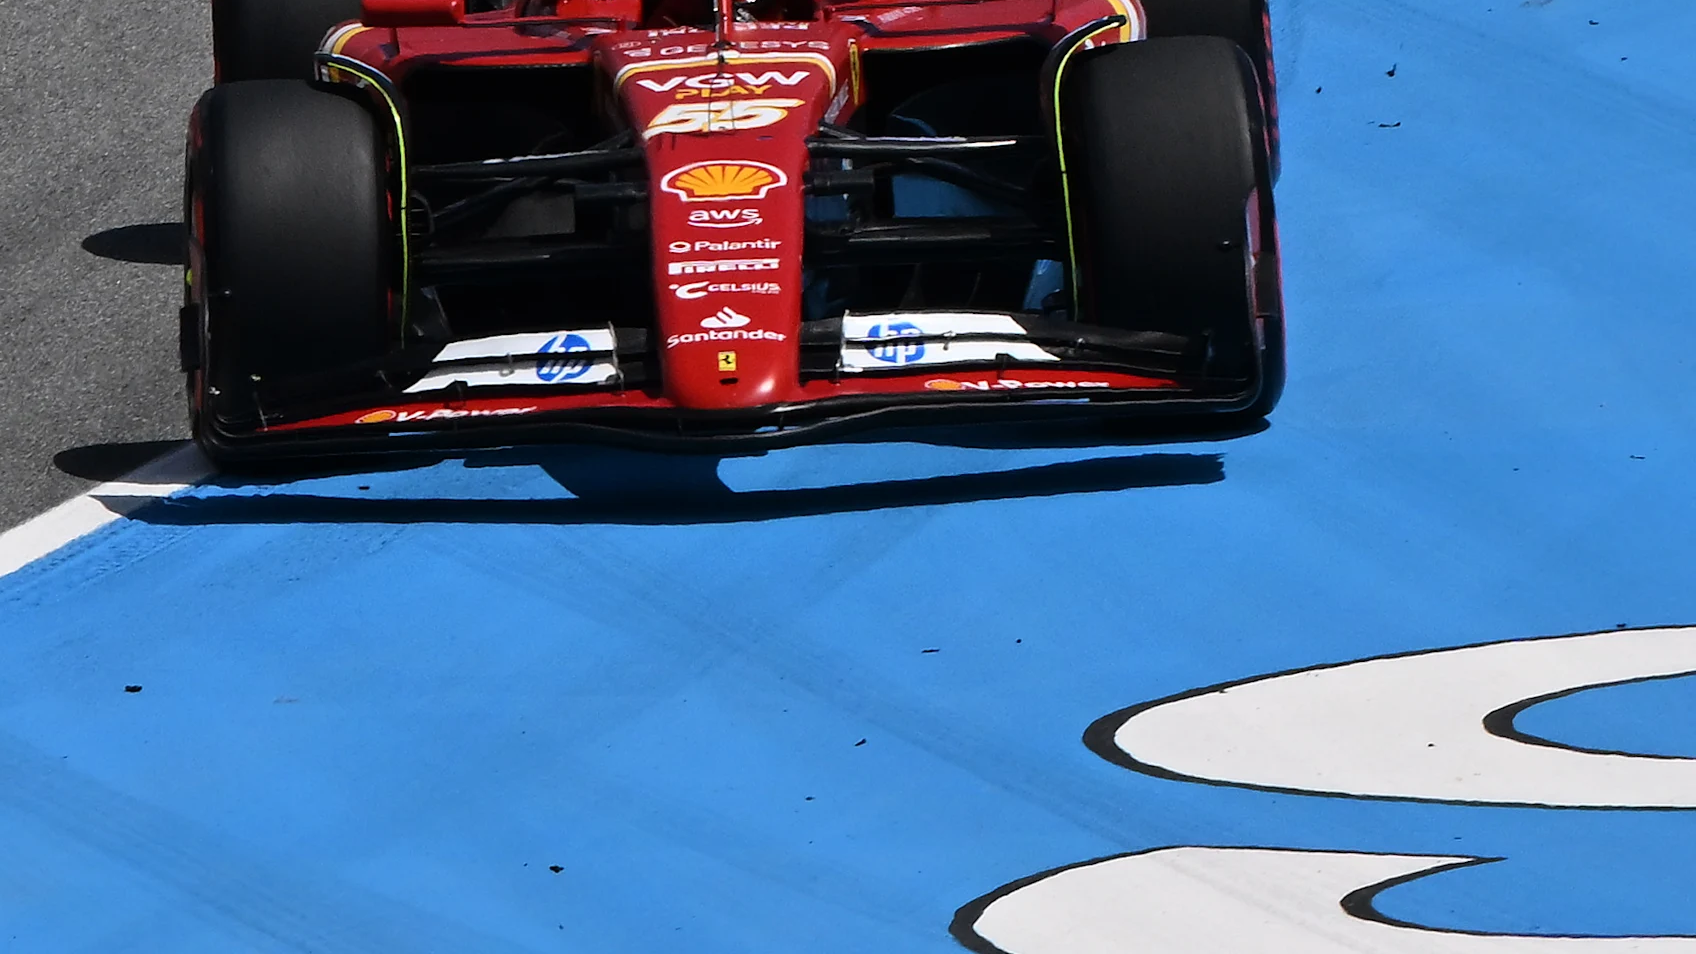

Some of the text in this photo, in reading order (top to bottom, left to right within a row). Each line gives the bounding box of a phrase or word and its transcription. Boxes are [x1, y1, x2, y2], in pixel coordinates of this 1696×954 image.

[636, 71, 810, 93] VGW
[675, 84, 773, 100] PLAY
[641, 98, 806, 142] 55
[688, 208, 761, 223] aws
[694, 238, 782, 252] Palantir
[668, 258, 781, 276] PIRELLI
[707, 282, 782, 293] CELSIUS
[667, 329, 787, 350] Santander
